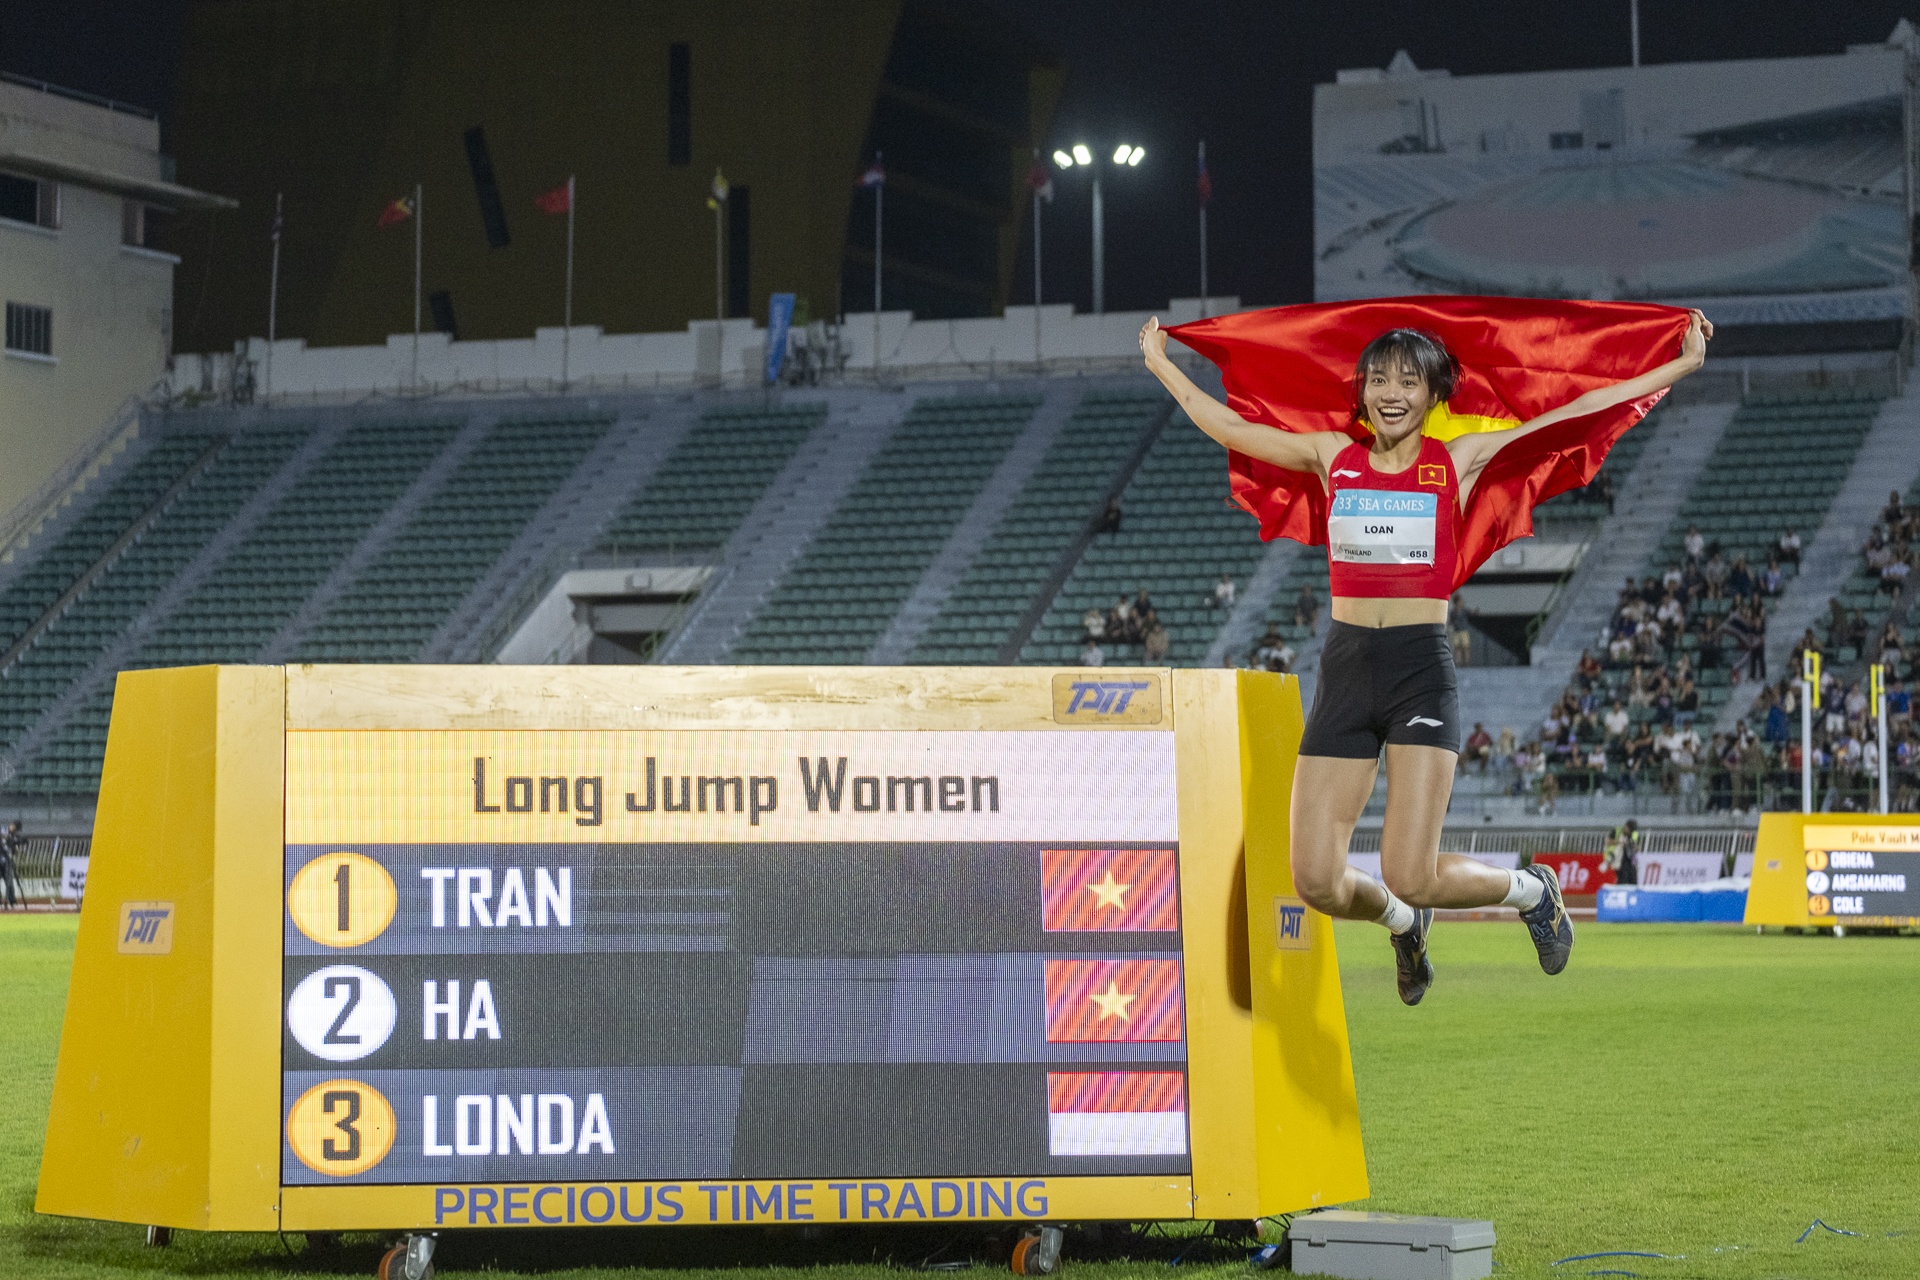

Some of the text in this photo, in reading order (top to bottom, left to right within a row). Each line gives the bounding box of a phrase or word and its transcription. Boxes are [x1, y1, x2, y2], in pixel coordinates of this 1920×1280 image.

[1358, 498, 1380, 511] SEA
[1383, 499, 1425, 511] GAMES
[1364, 525, 1394, 534] LOAN
[1409, 550, 1428, 558] 658
[474, 757, 1000, 826] Long Jump Women
[1851, 831, 1875, 844] Pole
[1879, 832, 1907, 844] Vault
[333, 864, 571, 932] 1 TRAN
[1833, 896, 1864, 914] COLE
[323, 976, 501, 1045] 2 HA
[322, 1091, 616, 1161] 3 LONDA
[435, 1180, 1050, 1225] PRECIOUS TIME TRADING
